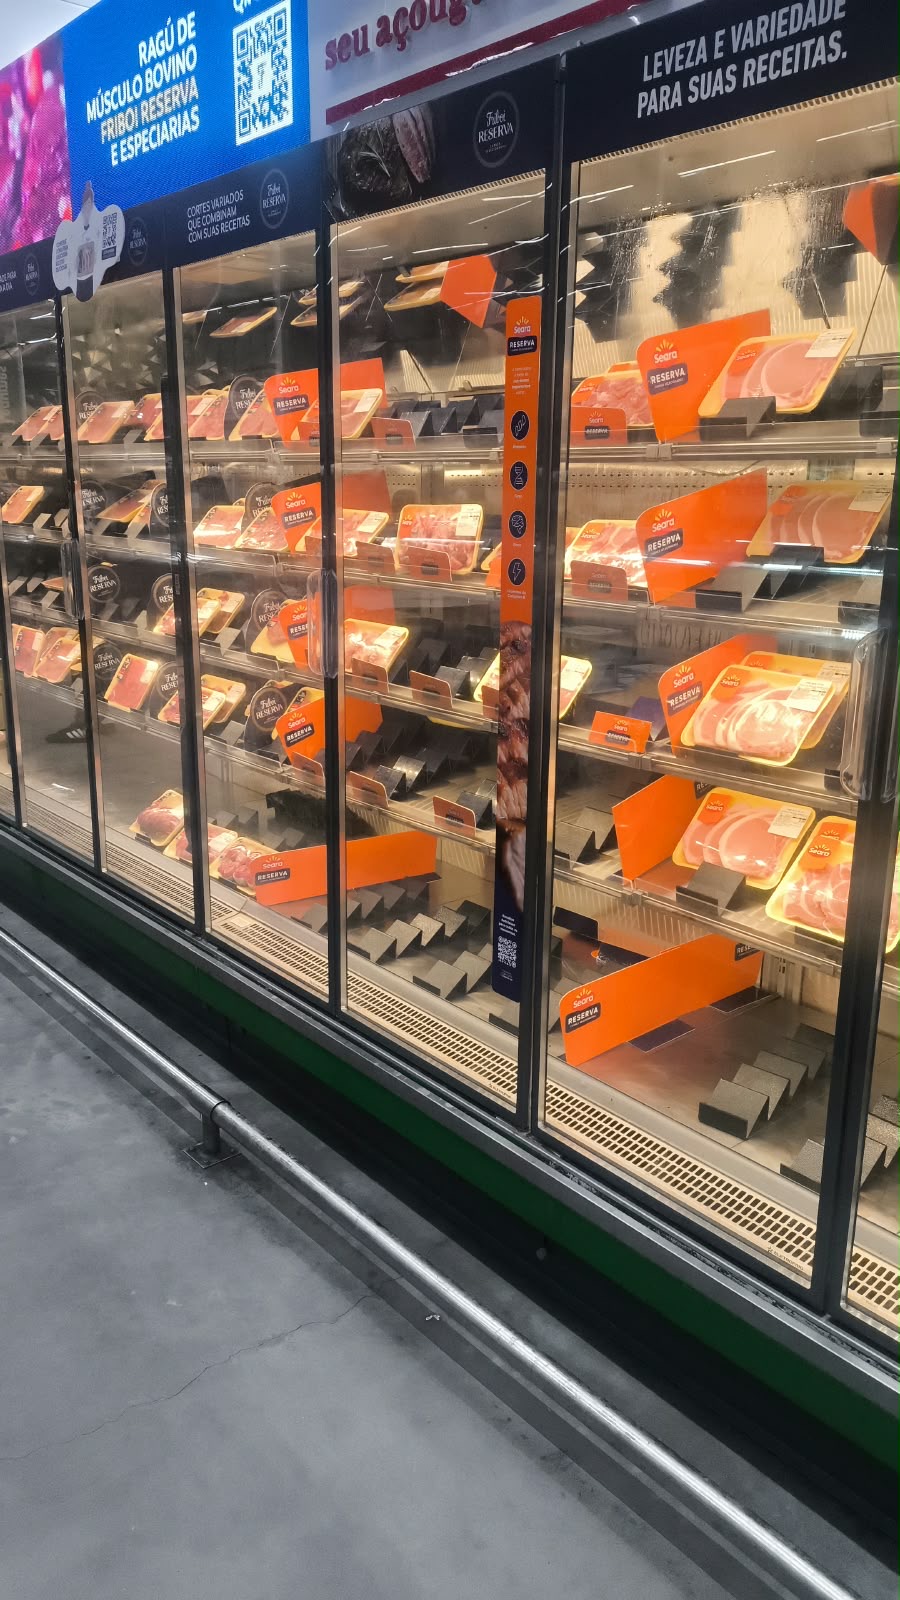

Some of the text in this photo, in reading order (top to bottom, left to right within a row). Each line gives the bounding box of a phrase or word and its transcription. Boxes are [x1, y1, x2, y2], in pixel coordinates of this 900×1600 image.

[138, 10, 197, 67] RAGÚ DE
[325, 23, 370, 70] seu
[643, 0, 846, 82] LEVEZA E VARIEDADE
[637, 30, 848, 118] PARA SUAS RECEITAS.
[86, 44, 198, 124] MÚSCULO BOVINO
[100, 82, 199, 145] FRIBOI RESERVA
[110, 105, 200, 167] E ESPECIARIAS
[478, 122, 514, 143] RESERVA
[187, 189, 244, 218] CORTES VARIADOS
[262, 193, 286, 209] RESERVA
[187, 205, 237, 231] QUE COMBINAM
[188, 214, 251, 244] COM SUAS RECEITAS
[509, 339, 535, 348] RESERVA
[653, 350, 678, 364] Seara
[650, 367, 686, 385] RESERVA
[278, 385, 299, 394] Seara
[276, 397, 307, 409] RESERVA
[285, 499, 306, 509] Seara
[284, 509, 314, 523] RESERVA
[651, 517, 675, 532] Seara
[647, 532, 681, 552] RESERVA
[89, 580, 117, 592] RESERVA
[292, 612, 308, 621] Sear
[94, 658, 121, 671] RESERVA
[673, 673, 695, 688] Seara
[721, 678, 740, 687] Seara
[670, 686, 701, 706] RESERVA
[255, 703, 284, 720] RESERVA
[287, 717, 306, 729] Seara
[286, 725, 313, 742] RESERVA
[808, 847, 831, 857] Seara
[262, 861, 283, 870] Seara
[257, 870, 288, 881] RESERVA
[572, 993, 594, 1009] Seara
[567, 1006, 599, 1026] RESERVA
